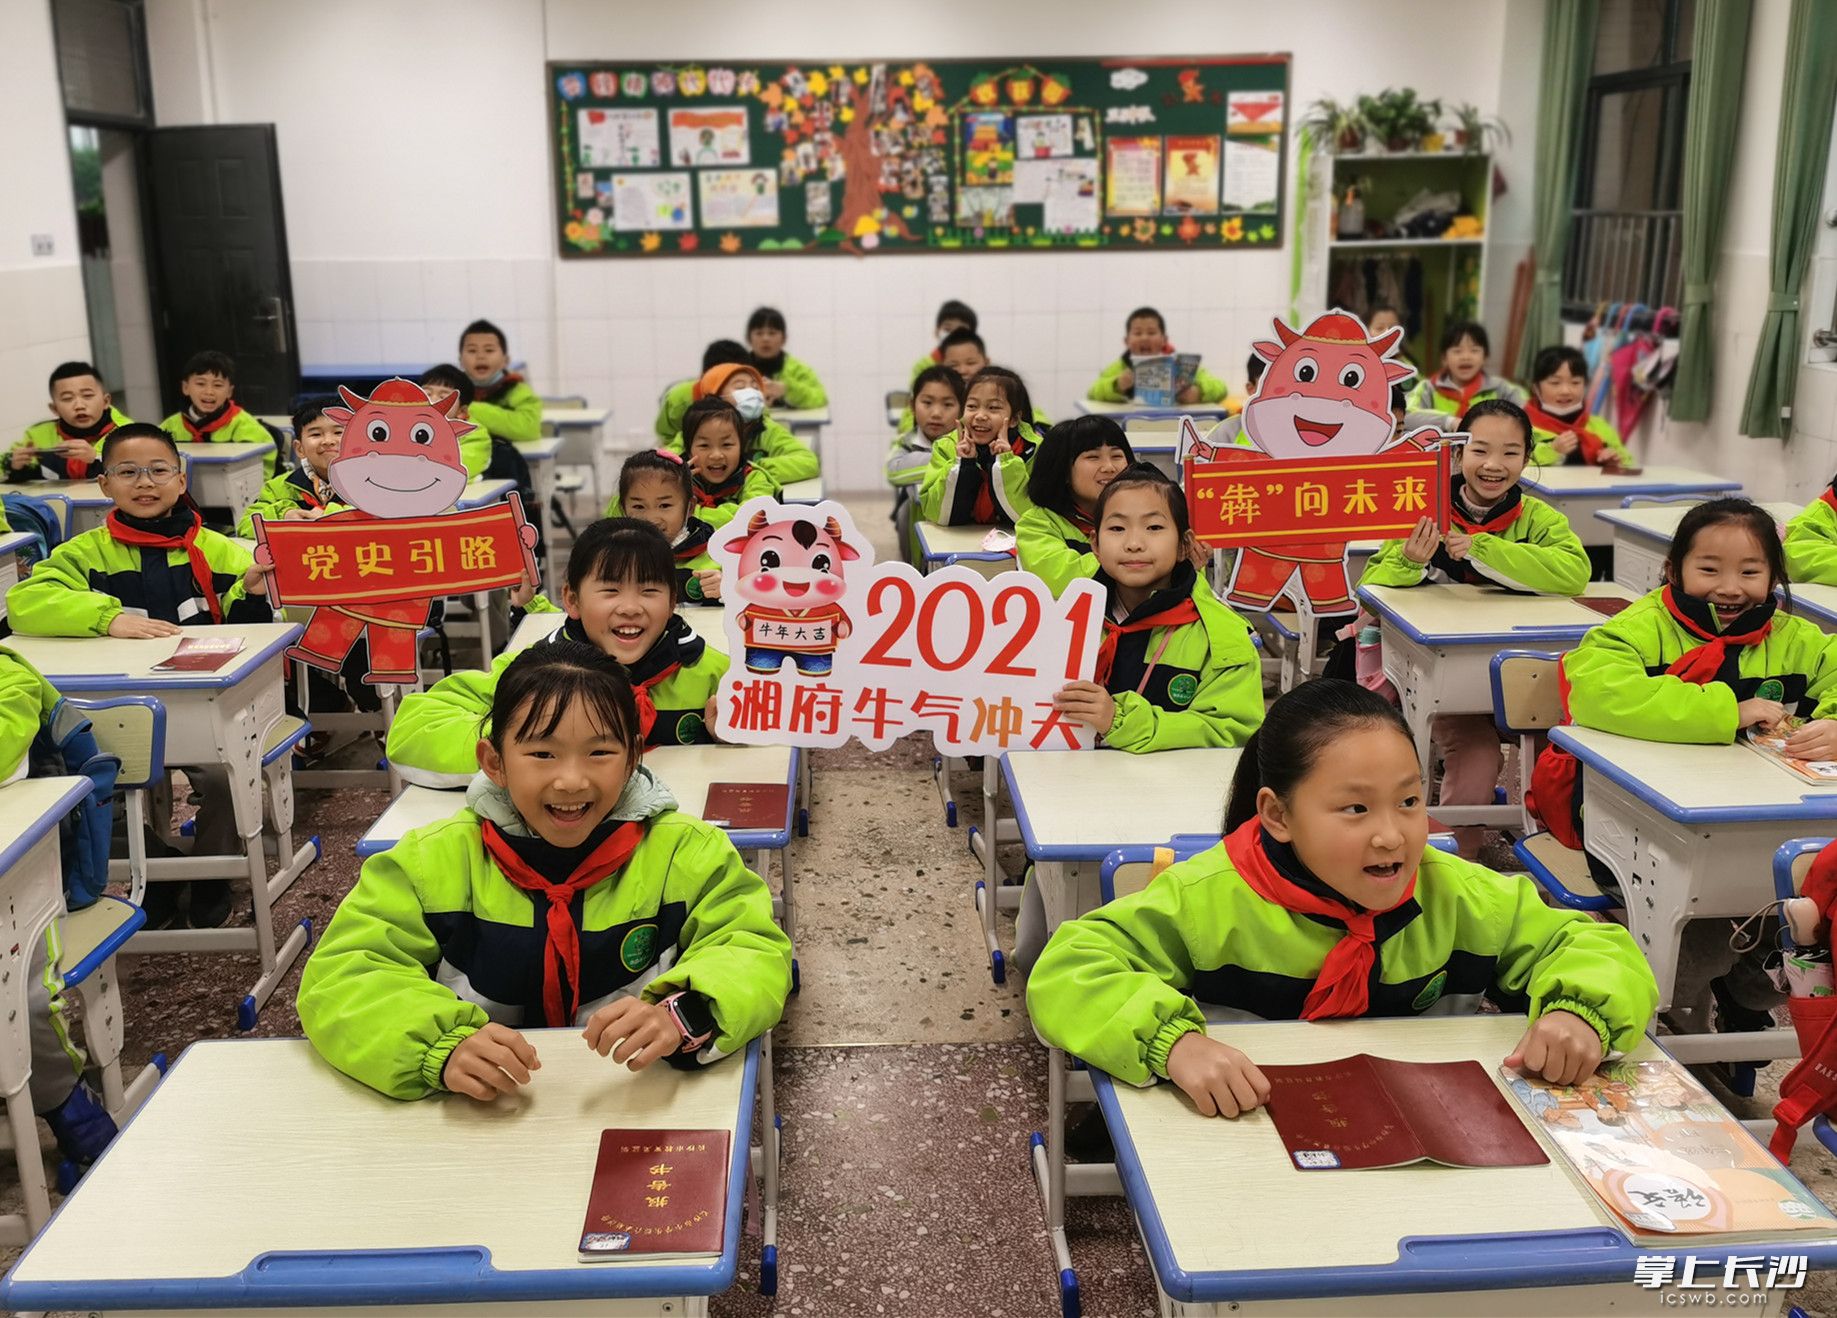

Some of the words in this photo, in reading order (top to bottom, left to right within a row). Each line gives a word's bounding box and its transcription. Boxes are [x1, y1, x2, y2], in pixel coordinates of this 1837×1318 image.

[1197, 476, 1428, 525] “犇”向未来
[301, 535, 497, 581] 党史引路
[758, 624, 827, 641] 牛年大吉
[859, 576, 1093, 680] 2021
[728, 680, 1083, 750] 湘府牛气冲天
[644, 1163, 673, 1208] 报告书
[1628, 1187, 1707, 1208] 语文
